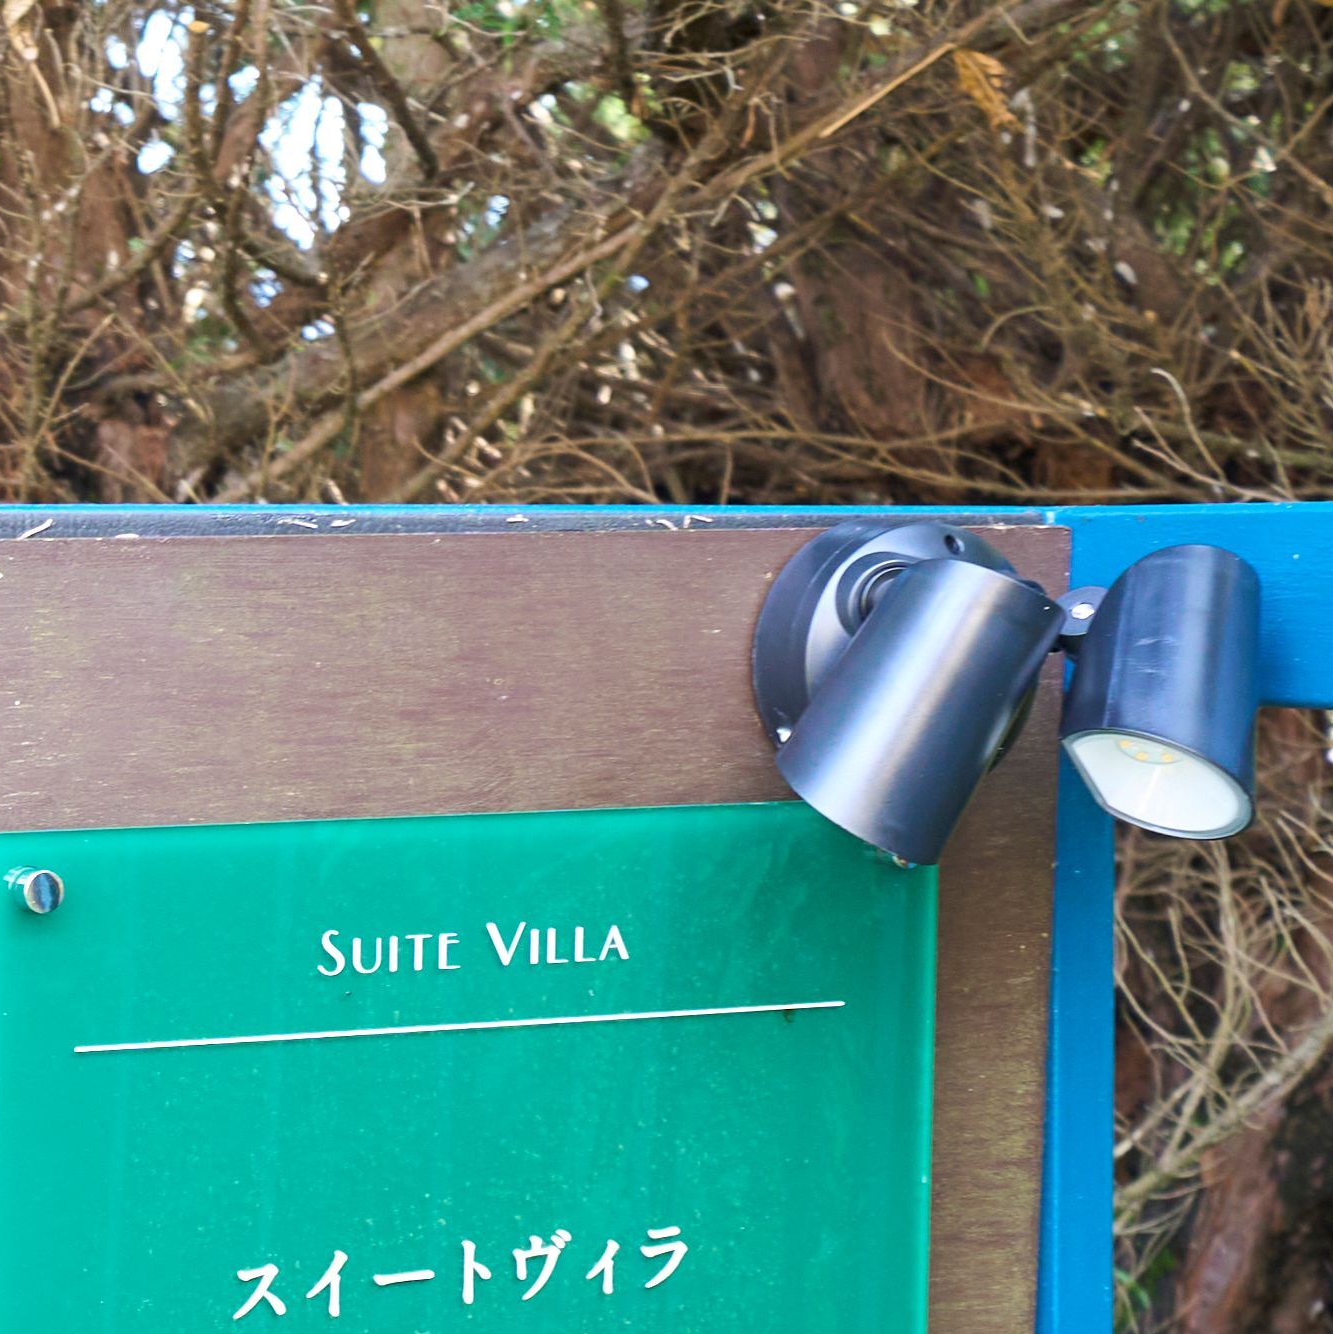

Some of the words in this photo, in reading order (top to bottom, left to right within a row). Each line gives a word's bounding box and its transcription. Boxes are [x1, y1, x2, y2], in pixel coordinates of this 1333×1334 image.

[317, 929, 462, 977] SUITE
[486, 921, 631, 966] VILLA
[232, 1226, 689, 1320] スイートヴィラ
